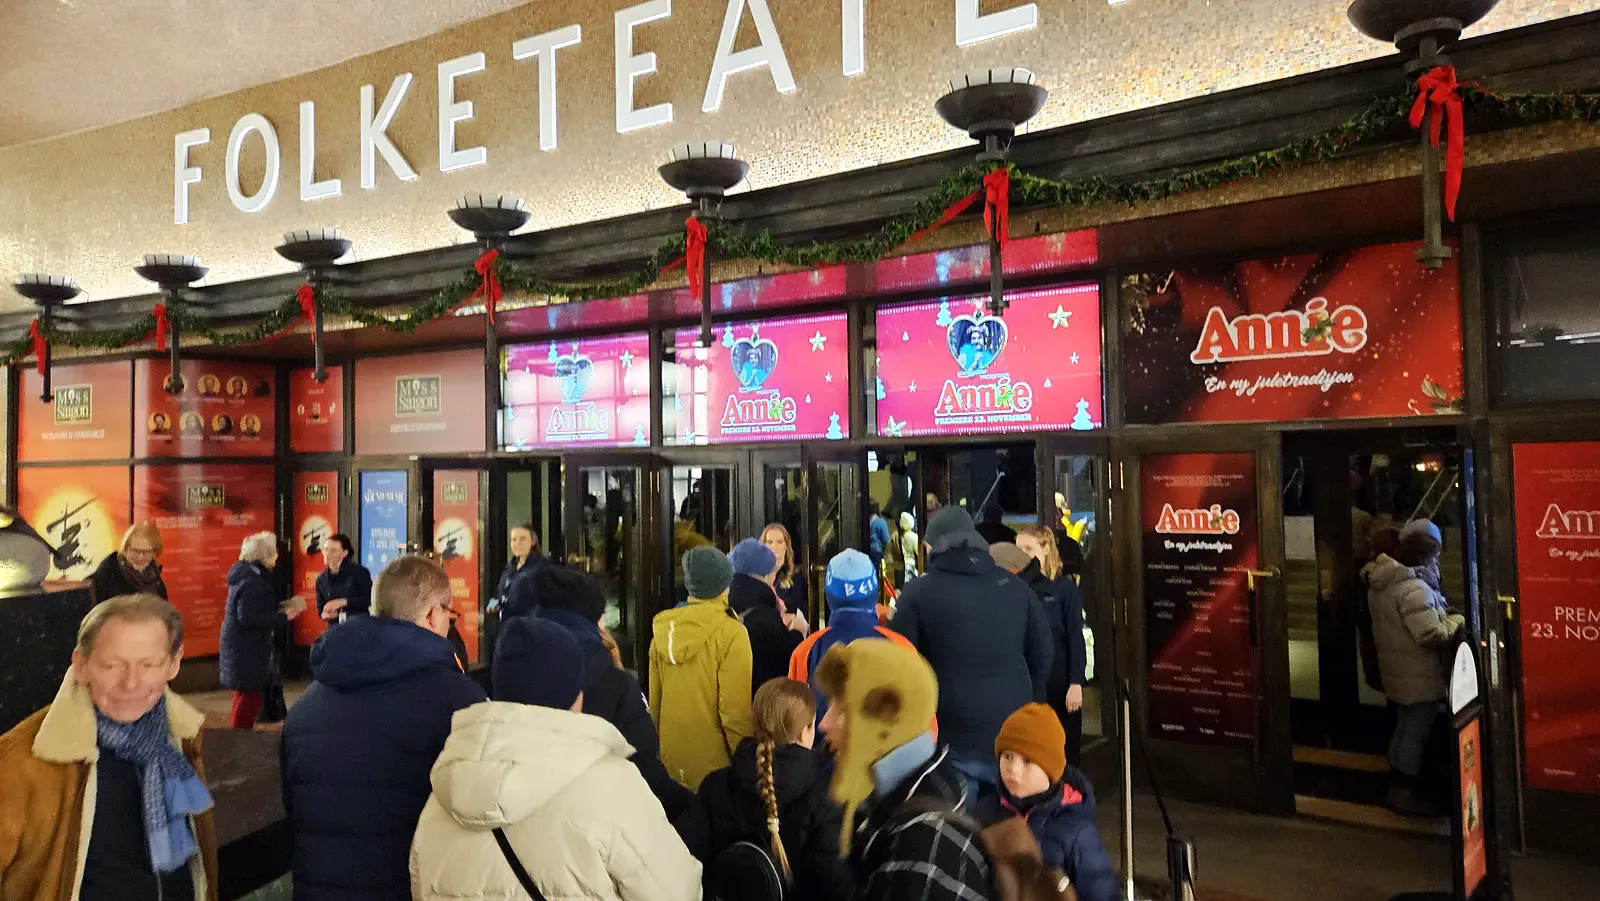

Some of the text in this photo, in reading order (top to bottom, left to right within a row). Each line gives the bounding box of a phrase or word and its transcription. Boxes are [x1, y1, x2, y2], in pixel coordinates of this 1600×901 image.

[1190, 296, 1367, 364] Annie
[934, 377, 1033, 416] Annie
[1205, 375, 1227, 393] En
[1229, 379, 1249, 396] ny
[721, 392, 796, 426] Annie
[1155, 503, 1240, 535] Annie
[1531, 623, 1559, 639] 23.
